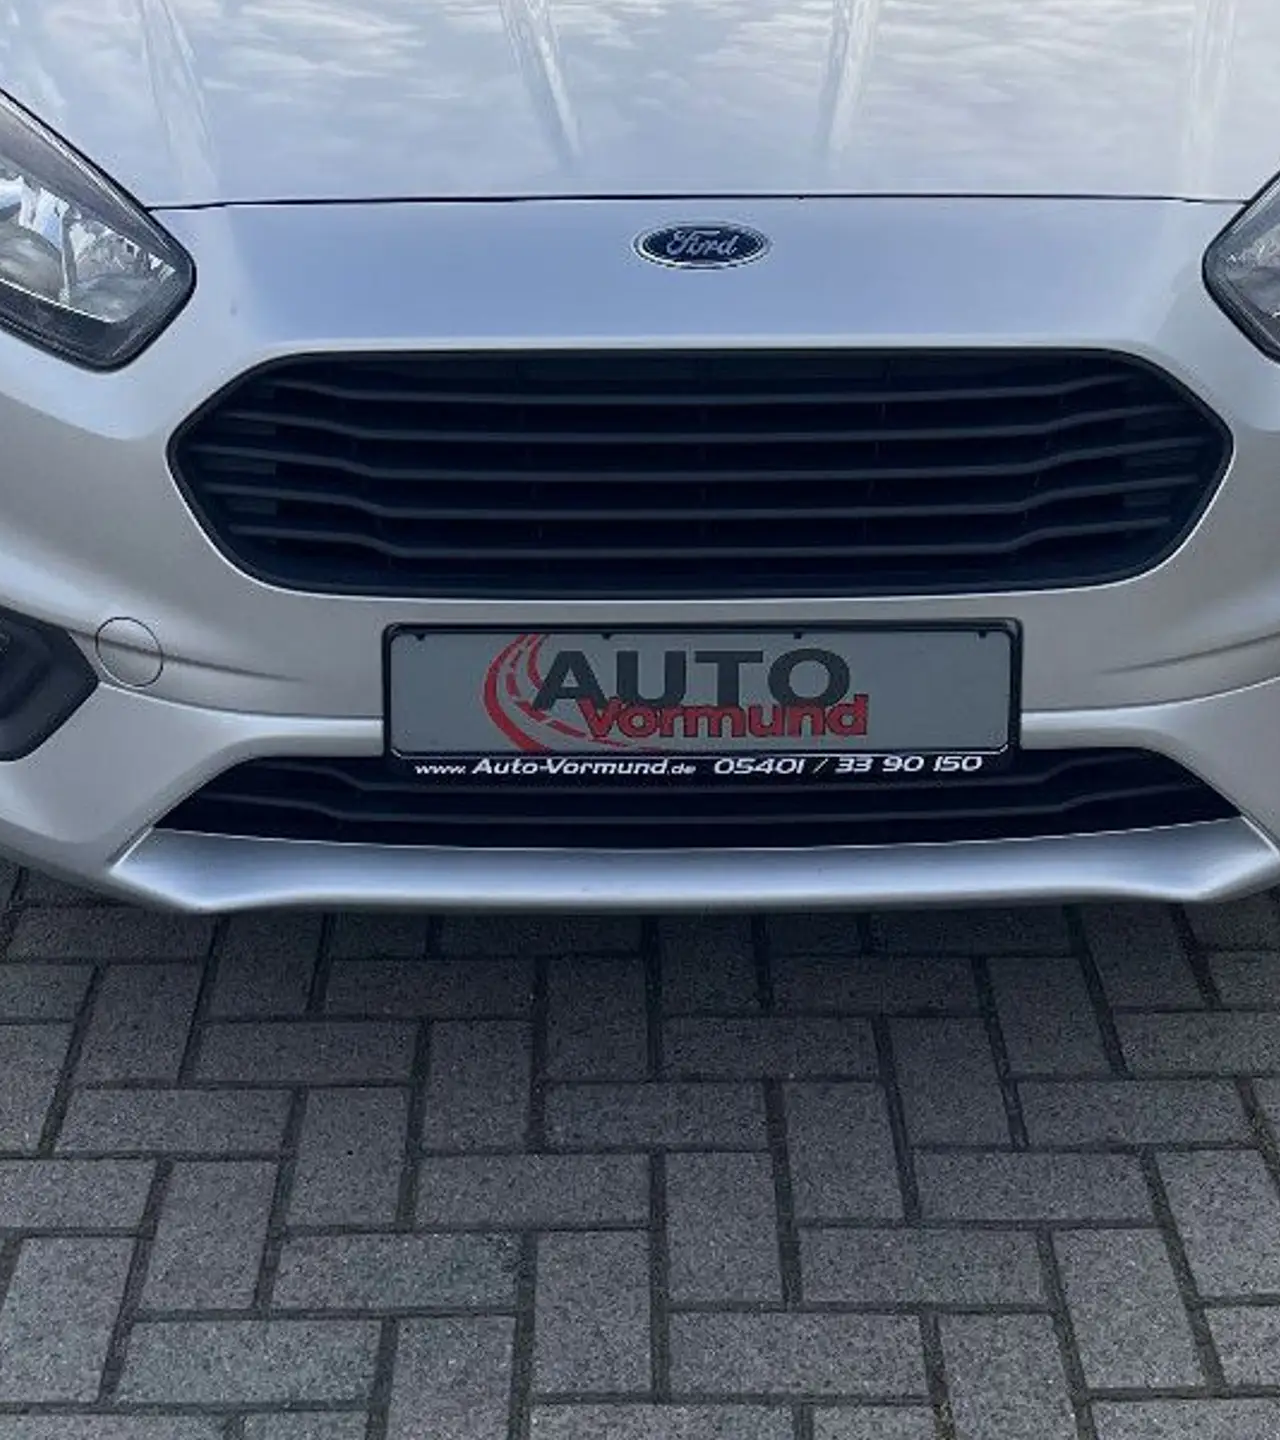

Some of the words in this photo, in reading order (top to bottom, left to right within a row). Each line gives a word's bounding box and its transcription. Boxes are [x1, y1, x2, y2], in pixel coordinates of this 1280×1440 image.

[666, 228, 740, 256] Ford
[531, 647, 851, 711] AUTO
[577, 693, 870, 739] Vormund
[713, 757, 805, 775] 05401
[835, 757, 874, 774] 33
[882, 756, 925, 773] 90
[933, 755, 983, 773] 150
